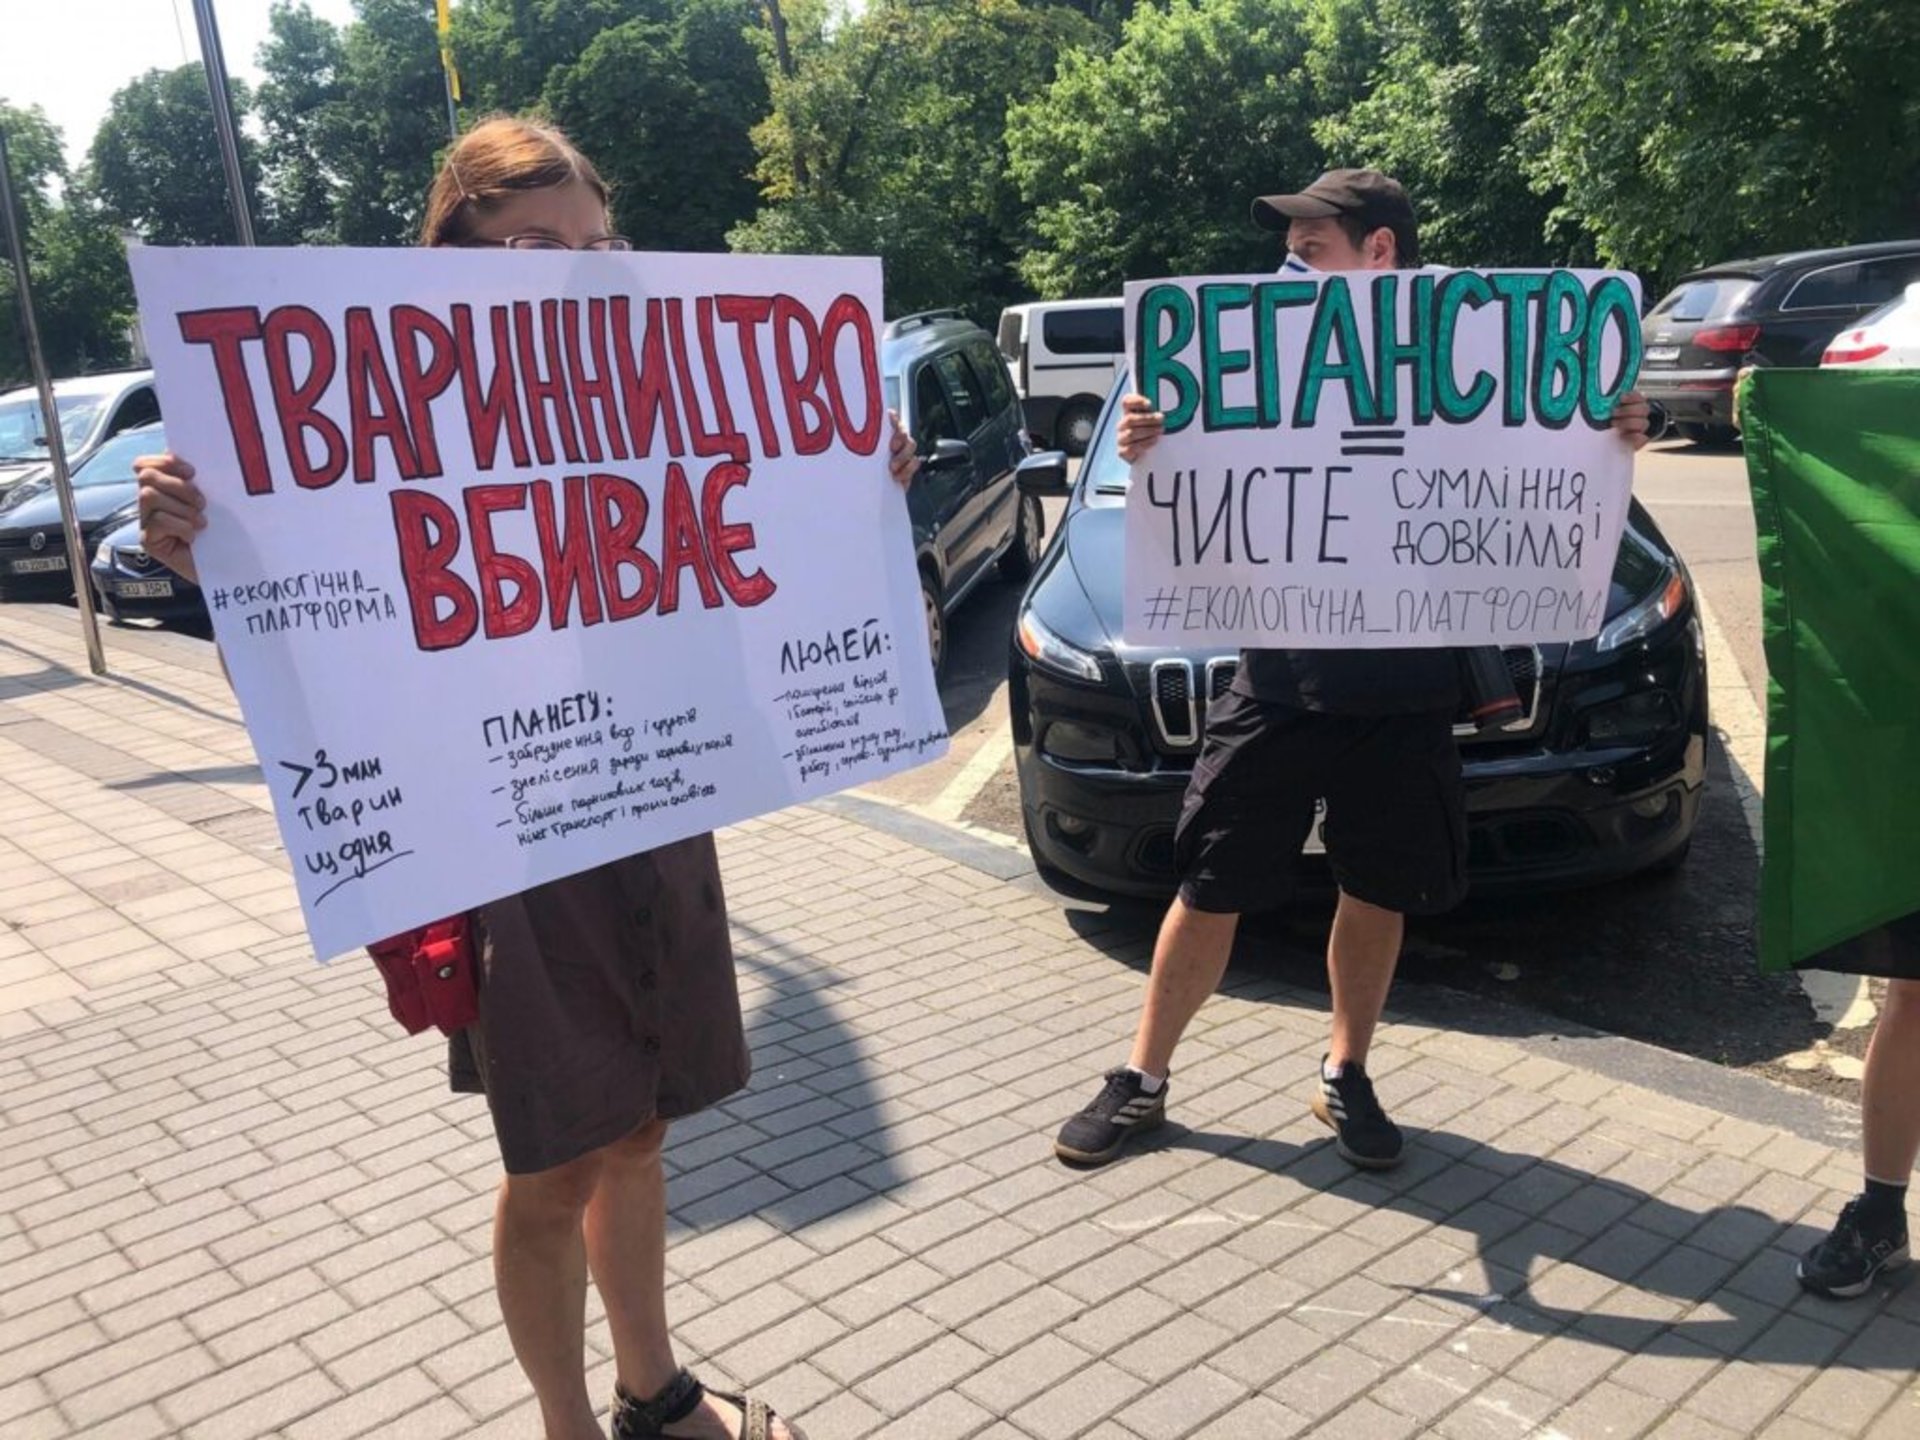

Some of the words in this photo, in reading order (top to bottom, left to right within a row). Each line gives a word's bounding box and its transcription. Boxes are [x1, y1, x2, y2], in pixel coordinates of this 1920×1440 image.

[1136, 269, 1642, 433] ВЕГАНСТВО
[176, 293, 883, 496] ТВАРИННИЦТВО
[1147, 465, 1353, 566] ЧИСТЕ
[391, 460, 777, 651] ВБИВАЄ
[246, 593, 397, 635] ПЛАТФОРМА
[781, 618, 892, 675] ЛЮДЕЙ:
[482, 690, 613, 748] ПЛАНЕТУ:
[507, 730, 603, 769] забруднення
[610, 722, 635, 752] вод
[514, 800, 564, 825] більше
[551, 808, 618, 839] транспорт
[305, 830, 395, 879] щодня
